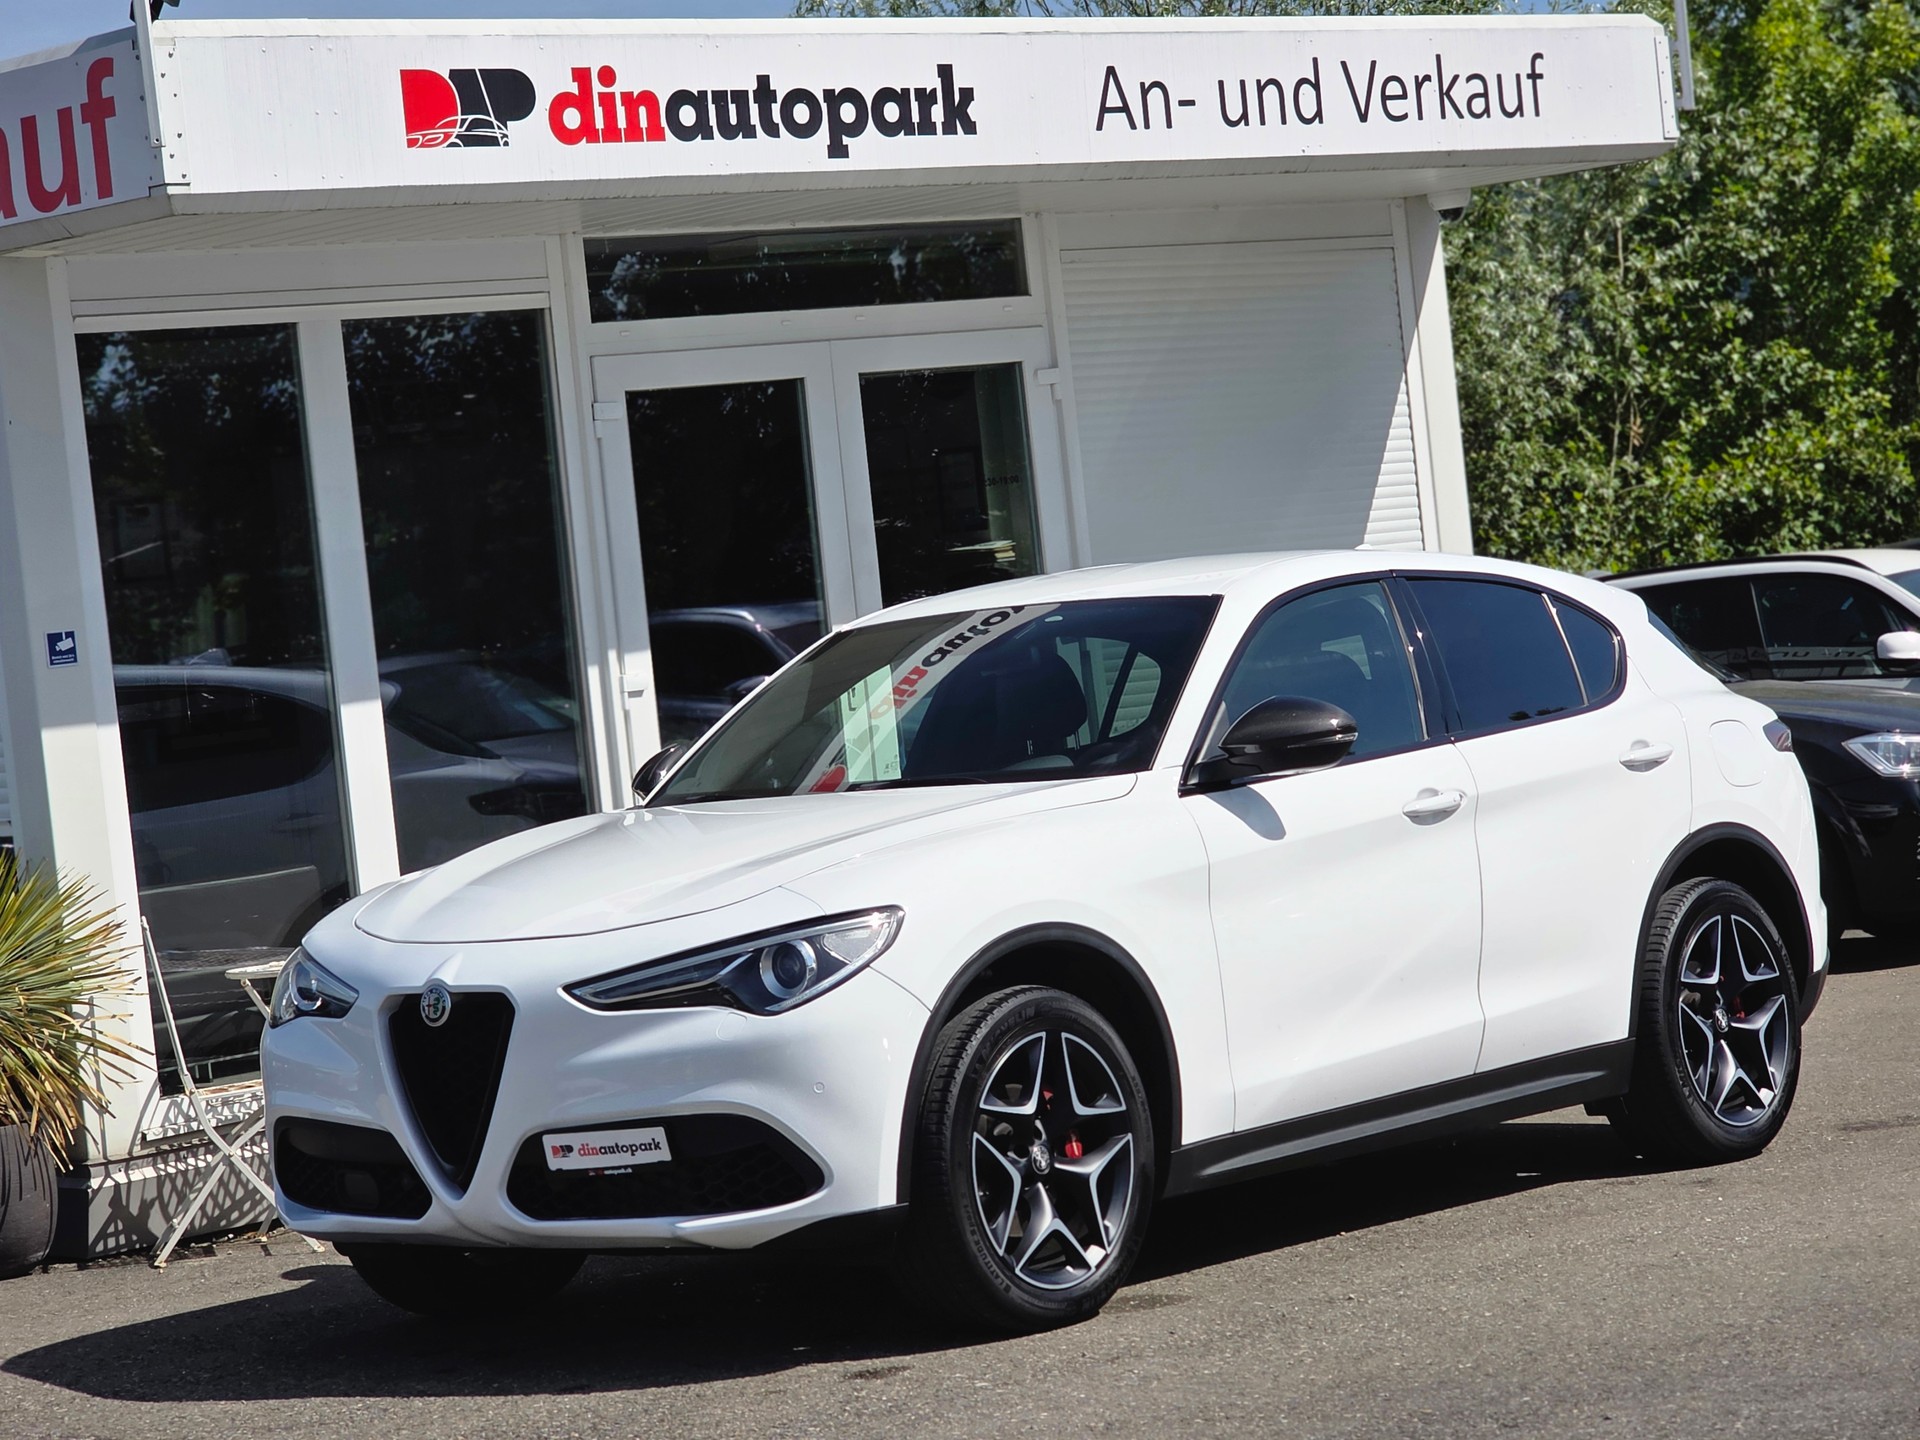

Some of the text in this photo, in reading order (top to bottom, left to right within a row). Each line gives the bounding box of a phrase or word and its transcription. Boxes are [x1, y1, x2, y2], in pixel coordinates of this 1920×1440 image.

[547, 64, 978, 158] dinautopark
[1096, 52, 1545, 132] An- und Verkauf
[578, 1138, 662, 1157] dinautopark
